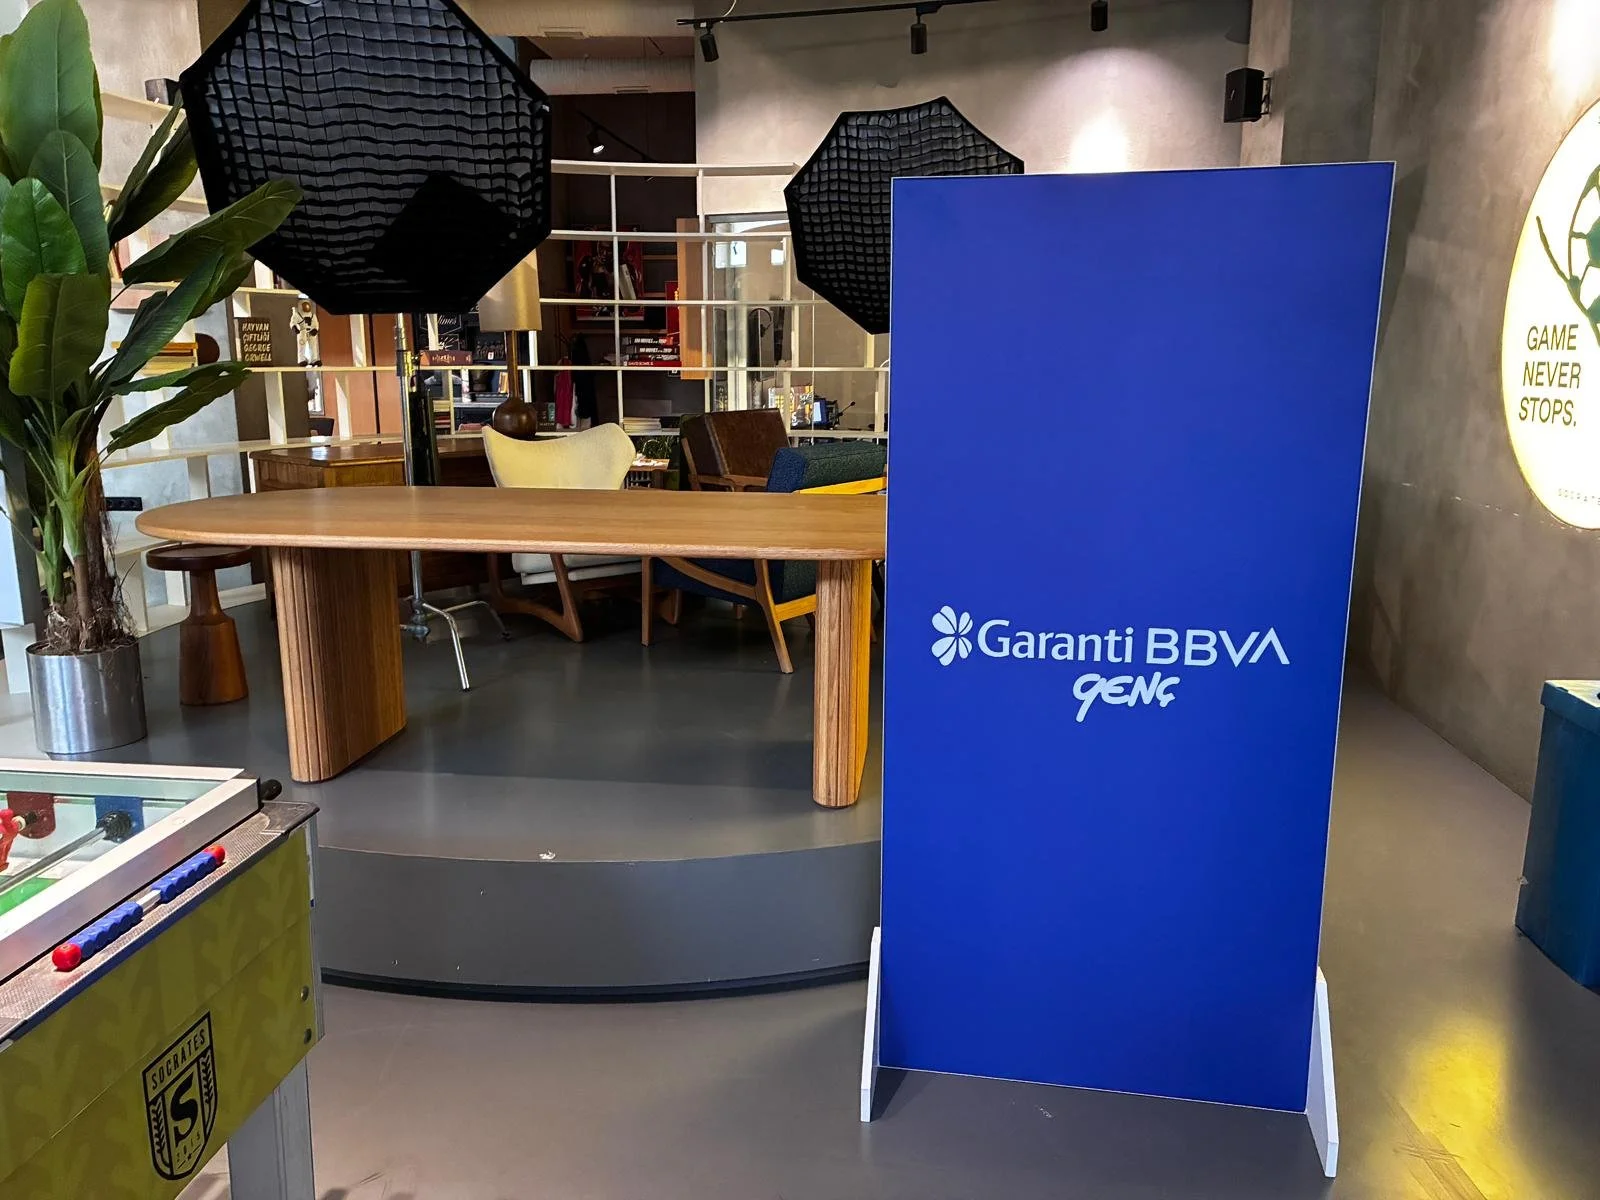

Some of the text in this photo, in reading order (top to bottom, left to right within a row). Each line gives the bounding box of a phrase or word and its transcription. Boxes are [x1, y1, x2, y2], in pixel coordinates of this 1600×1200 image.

[242, 322, 269, 331] HAYVAN
[1526, 323, 1579, 351] GAME
[243, 343, 271, 352] GEORGE
[244, 353, 272, 362] ORWELL
[1522, 361, 1581, 389] NEVER
[1518, 396, 1577, 427] STOPS.
[977, 618, 1290, 667] Garanti BBVA
[152, 1028, 206, 1091] SOCRATES
[170, 1071, 199, 1148] S
